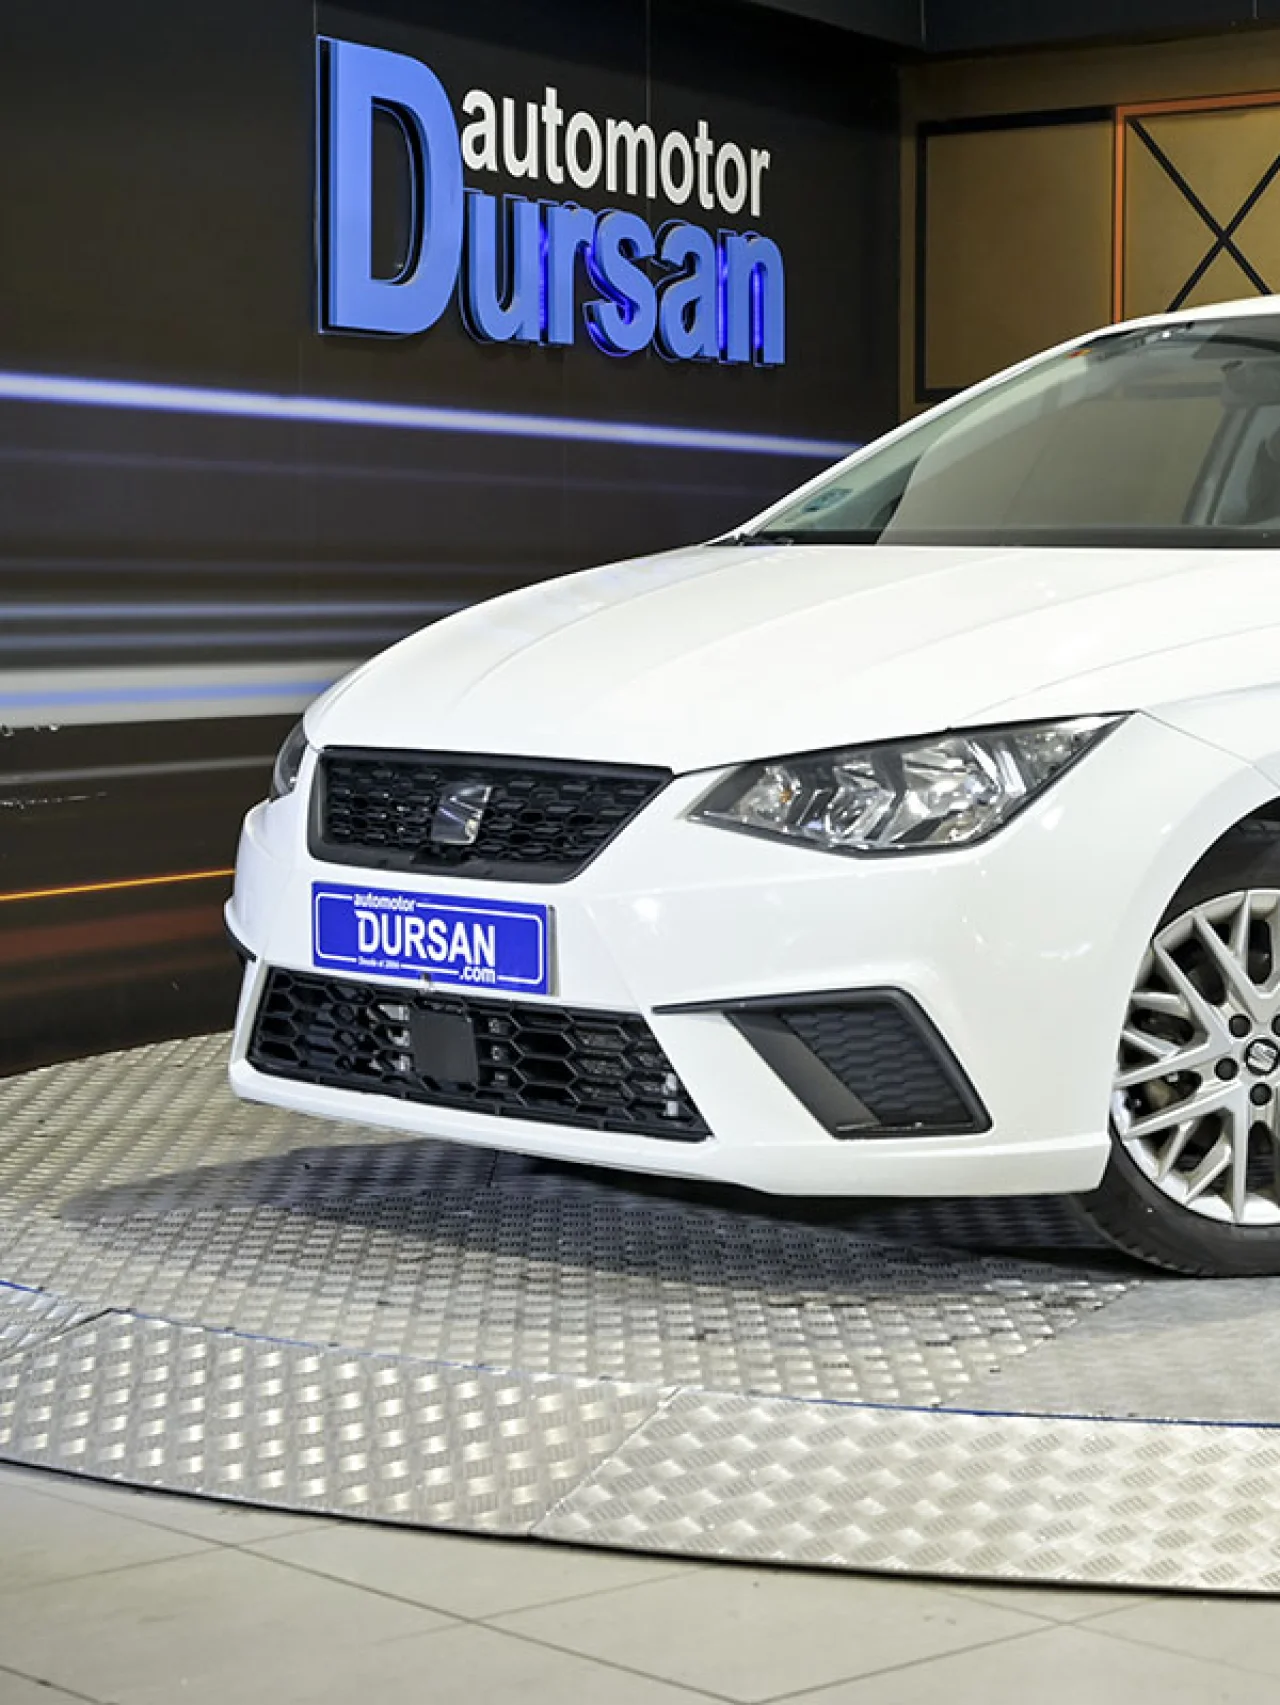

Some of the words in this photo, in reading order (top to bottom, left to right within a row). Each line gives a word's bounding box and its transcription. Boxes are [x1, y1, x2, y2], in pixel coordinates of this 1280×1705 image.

[461, 87, 771, 217] automotor
[316, 34, 786, 367] Dursan
[353, 891, 416, 912] automotor
[354, 909, 496, 967] DURSAN
[459, 966, 496, 984] .com
